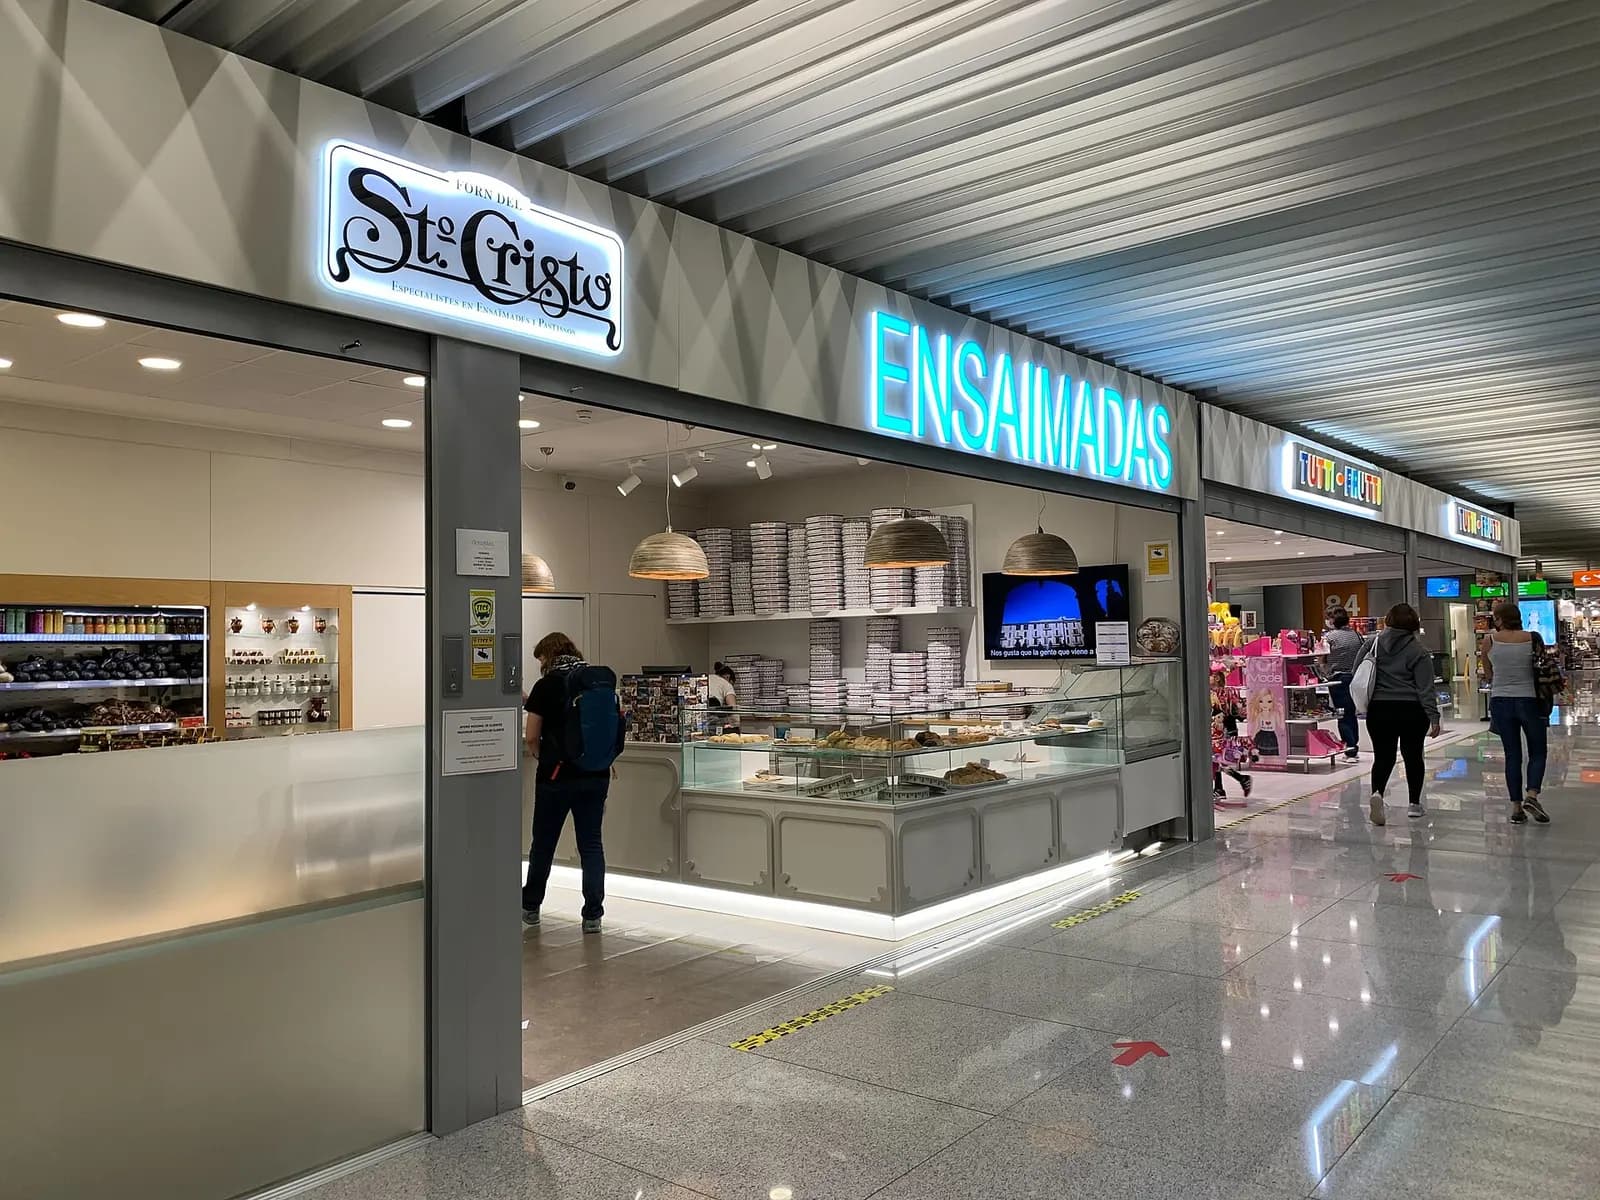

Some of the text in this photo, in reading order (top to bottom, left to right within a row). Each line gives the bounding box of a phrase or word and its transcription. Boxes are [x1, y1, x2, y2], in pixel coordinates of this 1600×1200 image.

[456, 179, 522, 210] FORN DEL
[461, 210, 611, 318] Cristo
[872, 311, 1172, 490] ENSAIMADAS
[1300, 451, 1382, 506] TUTTI FRUTTI
